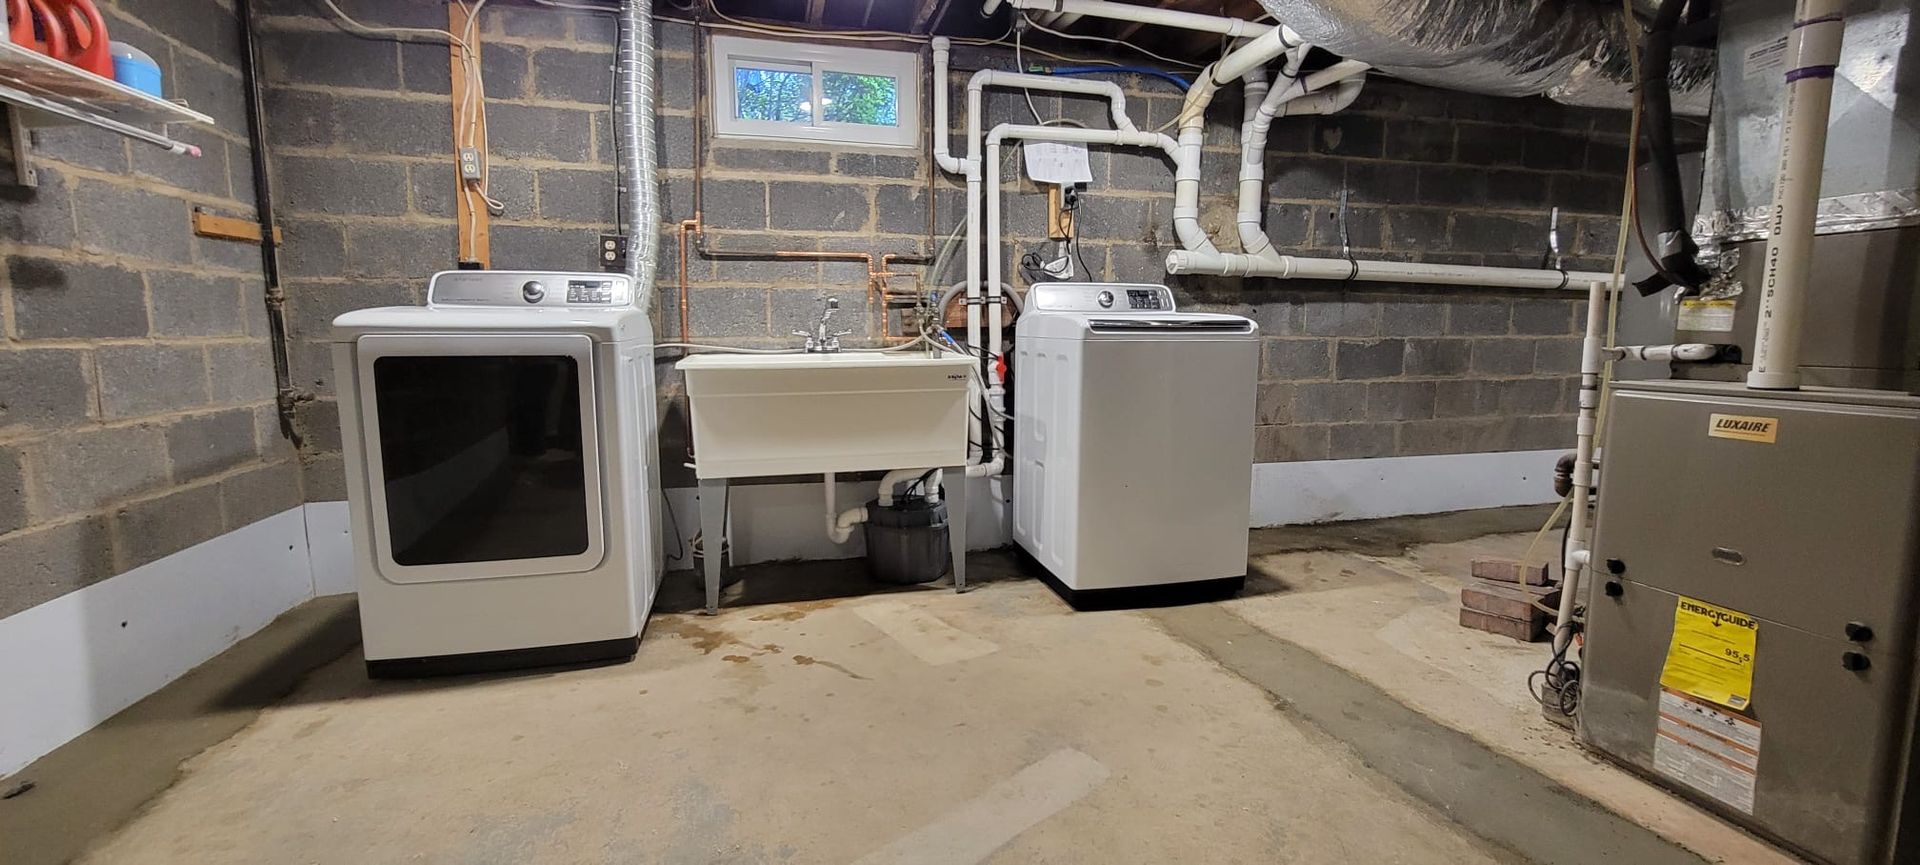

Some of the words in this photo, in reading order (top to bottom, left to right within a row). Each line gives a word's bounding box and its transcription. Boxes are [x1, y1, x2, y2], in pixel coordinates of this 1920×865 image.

[1773, 205, 1784, 236] DWV
[1716, 419, 1772, 433] LUXAIRE
[1680, 601, 1756, 630] ENERGYGUIDE
